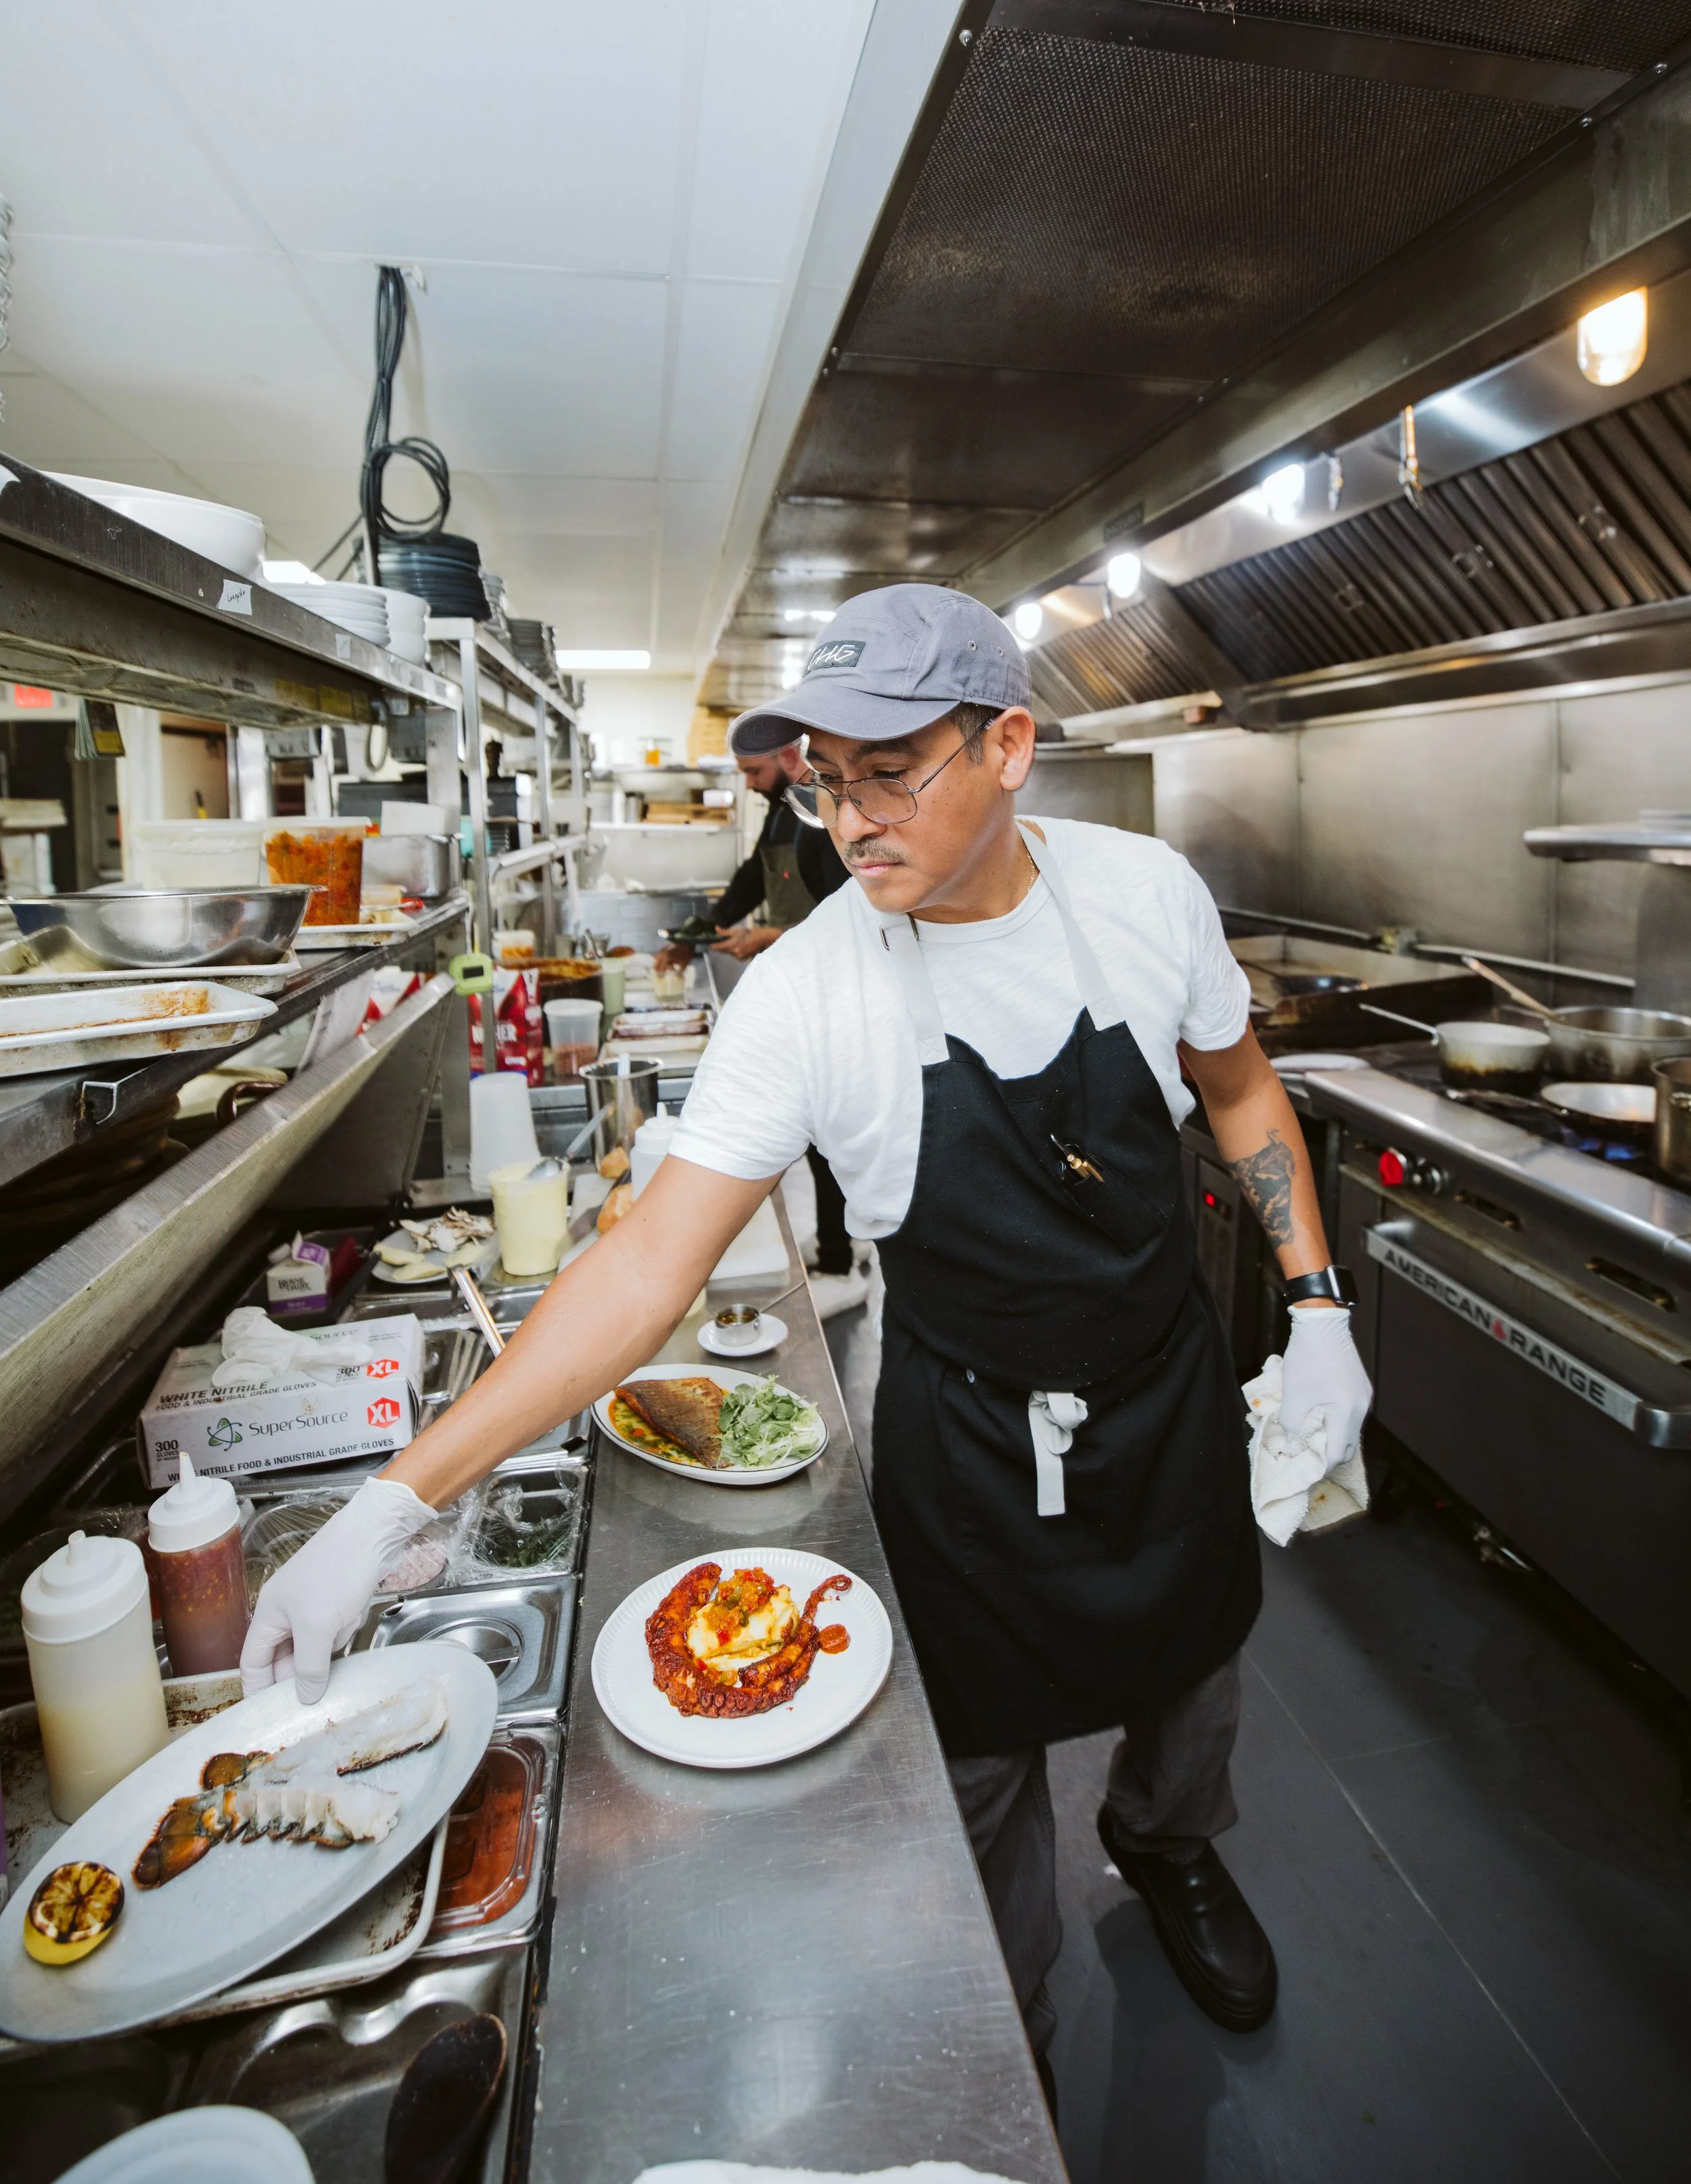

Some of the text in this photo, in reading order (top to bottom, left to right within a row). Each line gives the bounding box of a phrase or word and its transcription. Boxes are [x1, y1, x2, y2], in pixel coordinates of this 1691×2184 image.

[1385, 1249, 1606, 1407] AMERICAN RANGE
[336, 1365, 361, 1375] 300
[369, 1361, 398, 1376] XL
[156, 1402, 181, 1411] FOOD
[250, 1387, 280, 1397] GRADE
[283, 1382, 317, 1392] GLOVES
[160, 1381, 269, 1403] WHITE NITRILE
[249, 1411, 349, 1436] SuperSource
[370, 1403, 400, 1425] XL
[155, 1440, 179, 1452] 300
[200, 1464, 235, 1476] NITRILE
[237, 1460, 262, 1471] FOOD
[274, 1450, 326, 1465] INDUSTRIAL
[329, 1444, 359, 1455] GRADE
[361, 1438, 394, 1450] GLOVES
